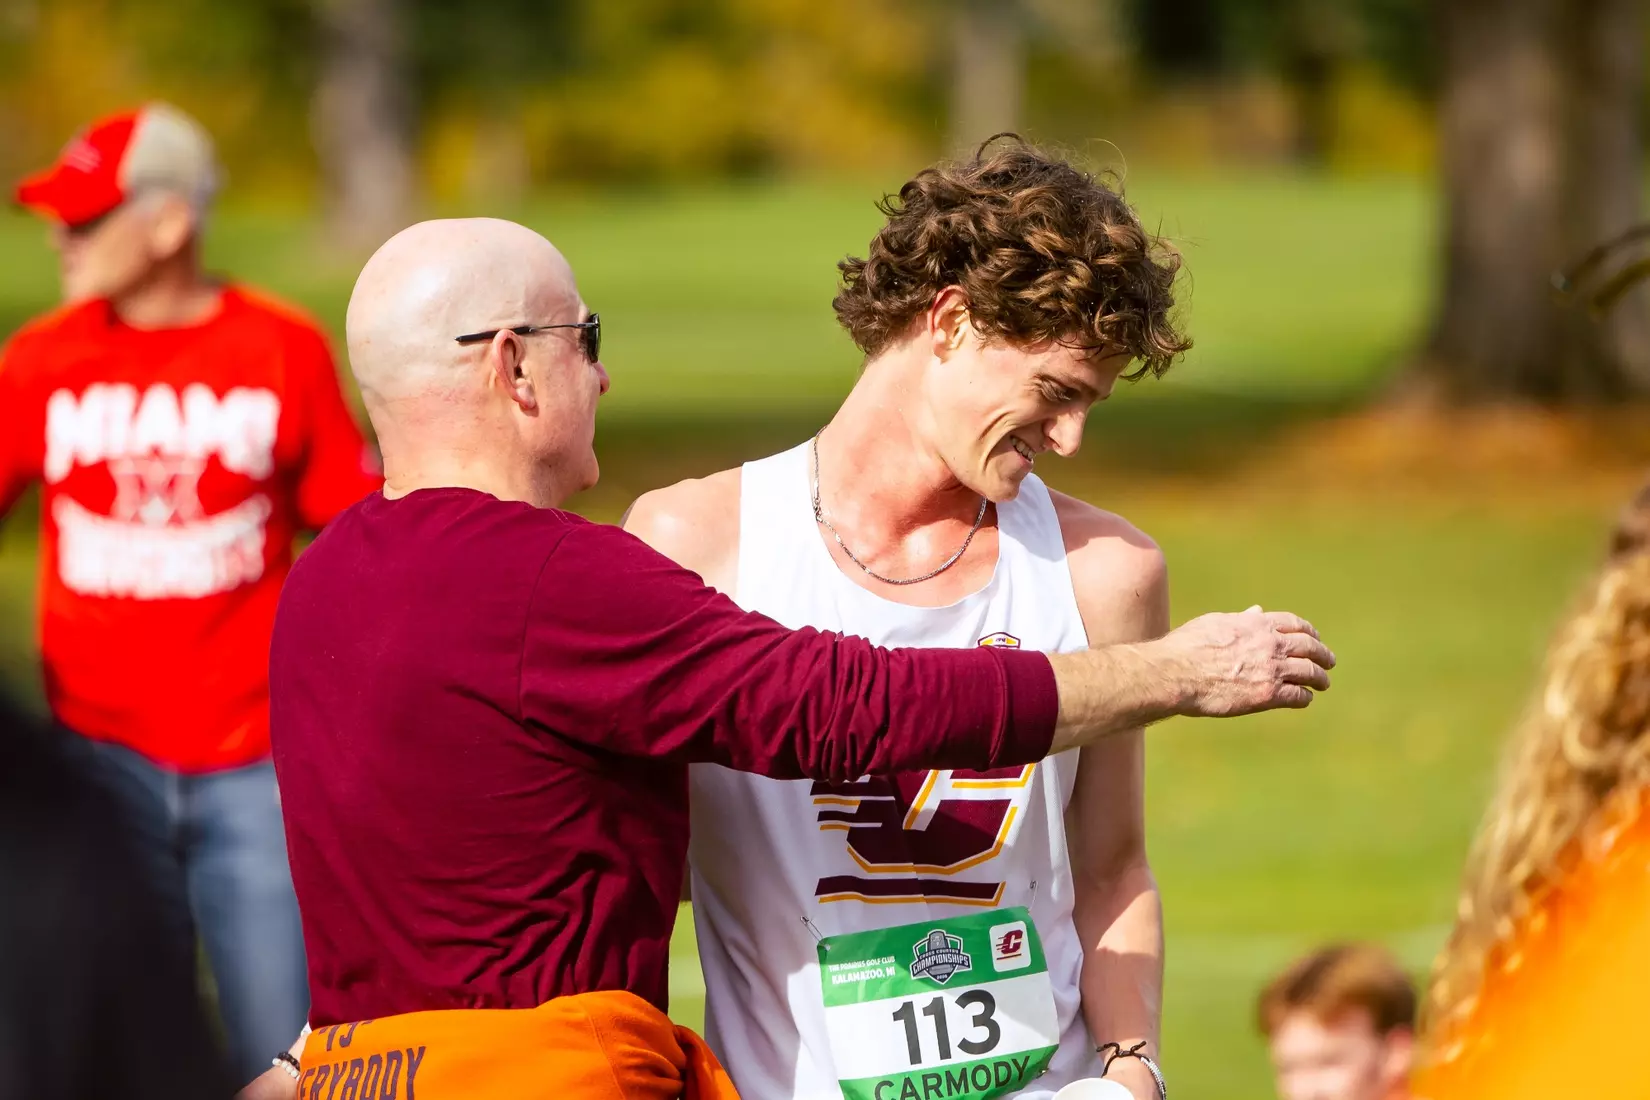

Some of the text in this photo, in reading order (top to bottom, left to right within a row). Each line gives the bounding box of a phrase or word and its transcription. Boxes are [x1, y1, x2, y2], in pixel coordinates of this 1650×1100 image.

[865, 957, 881, 967] GOLF
[881, 955, 895, 964] CLUB
[912, 953, 969, 975] CHAMPIONSHIPS
[831, 966, 895, 985] KALAMAZOO, MI
[892, 989, 1001, 1066] 113
[873, 1055, 1031, 1100] CARMODY
